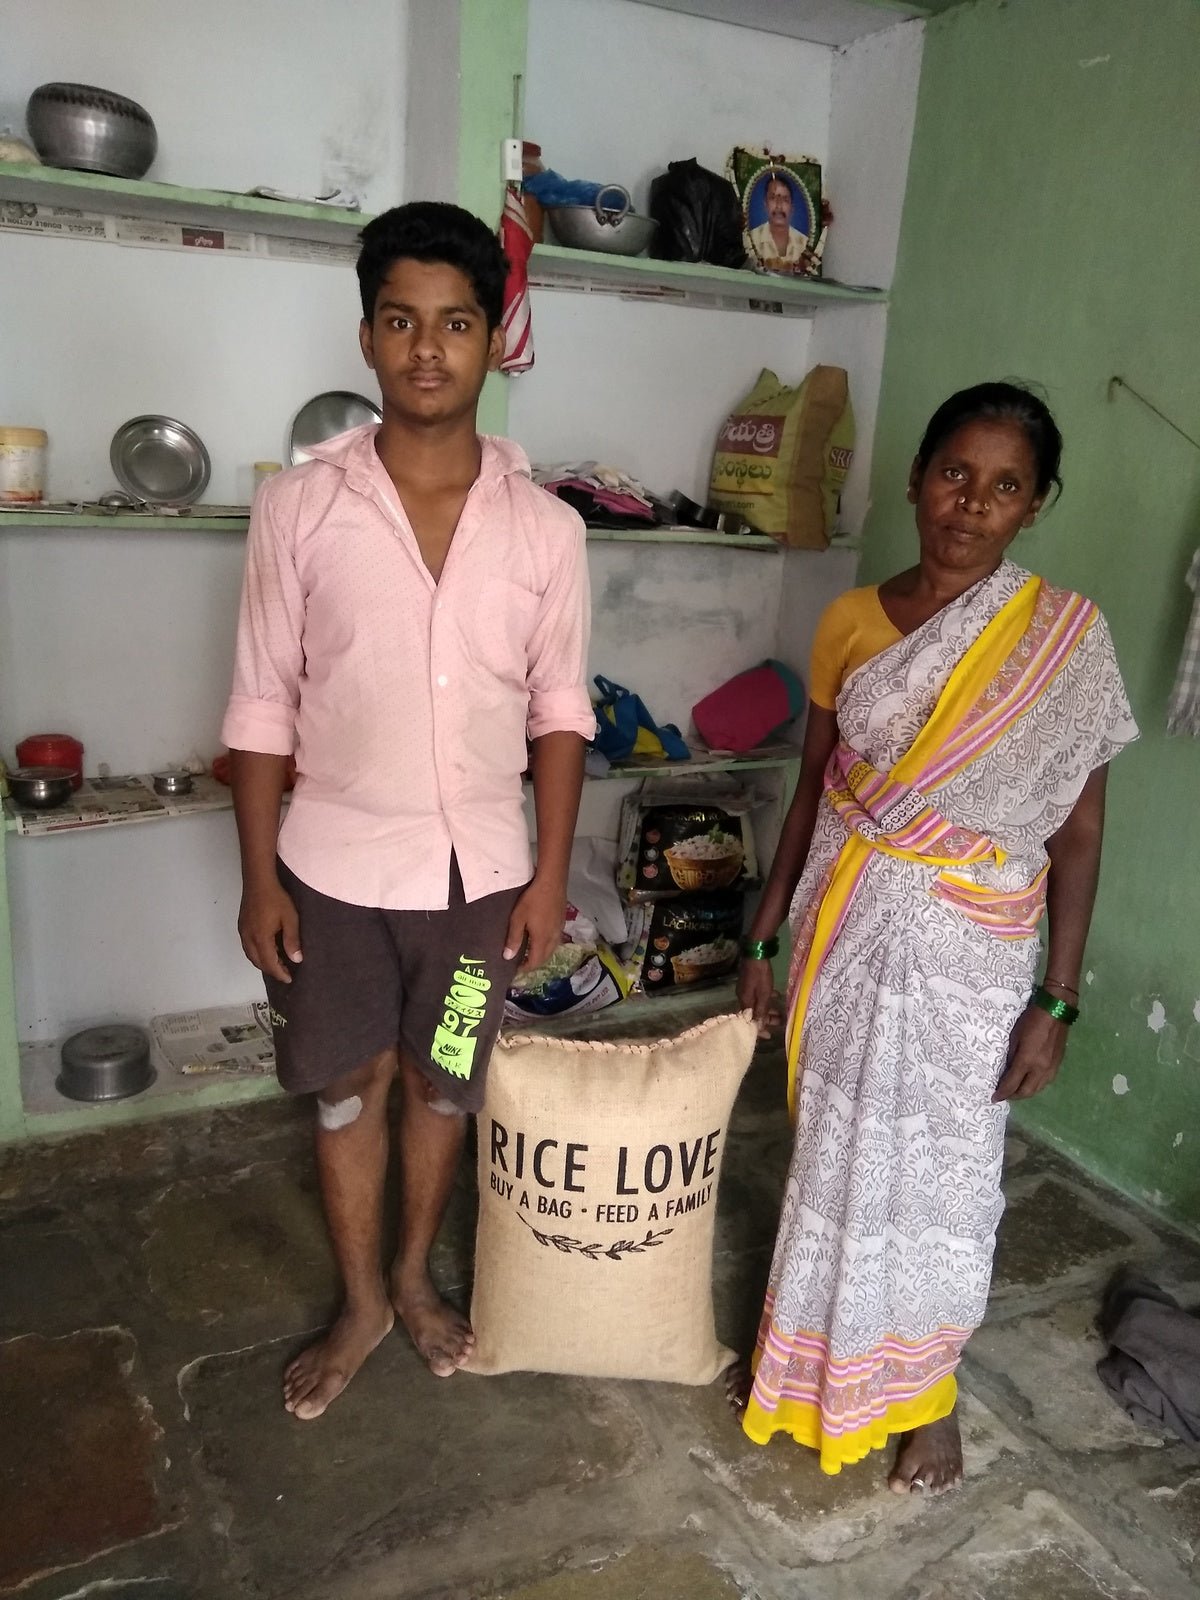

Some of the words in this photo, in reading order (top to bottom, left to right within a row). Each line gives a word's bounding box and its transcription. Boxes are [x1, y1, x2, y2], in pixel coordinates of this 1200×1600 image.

[464, 965, 485, 977] AIR
[443, 1009, 481, 1037] 97
[443, 1043, 463, 1056] NIKE
[491, 1118, 588, 1193] RICE
[616, 1128, 721, 1195] LOVE
[490, 1171, 514, 1200] BUY
[519, 1190, 530, 1209] A
[537, 1195, 572, 1219] BAG
[596, 1204, 639, 1223] FEED
[648, 1203, 658, 1221] A
[665, 1182, 713, 1218] FAMILY
